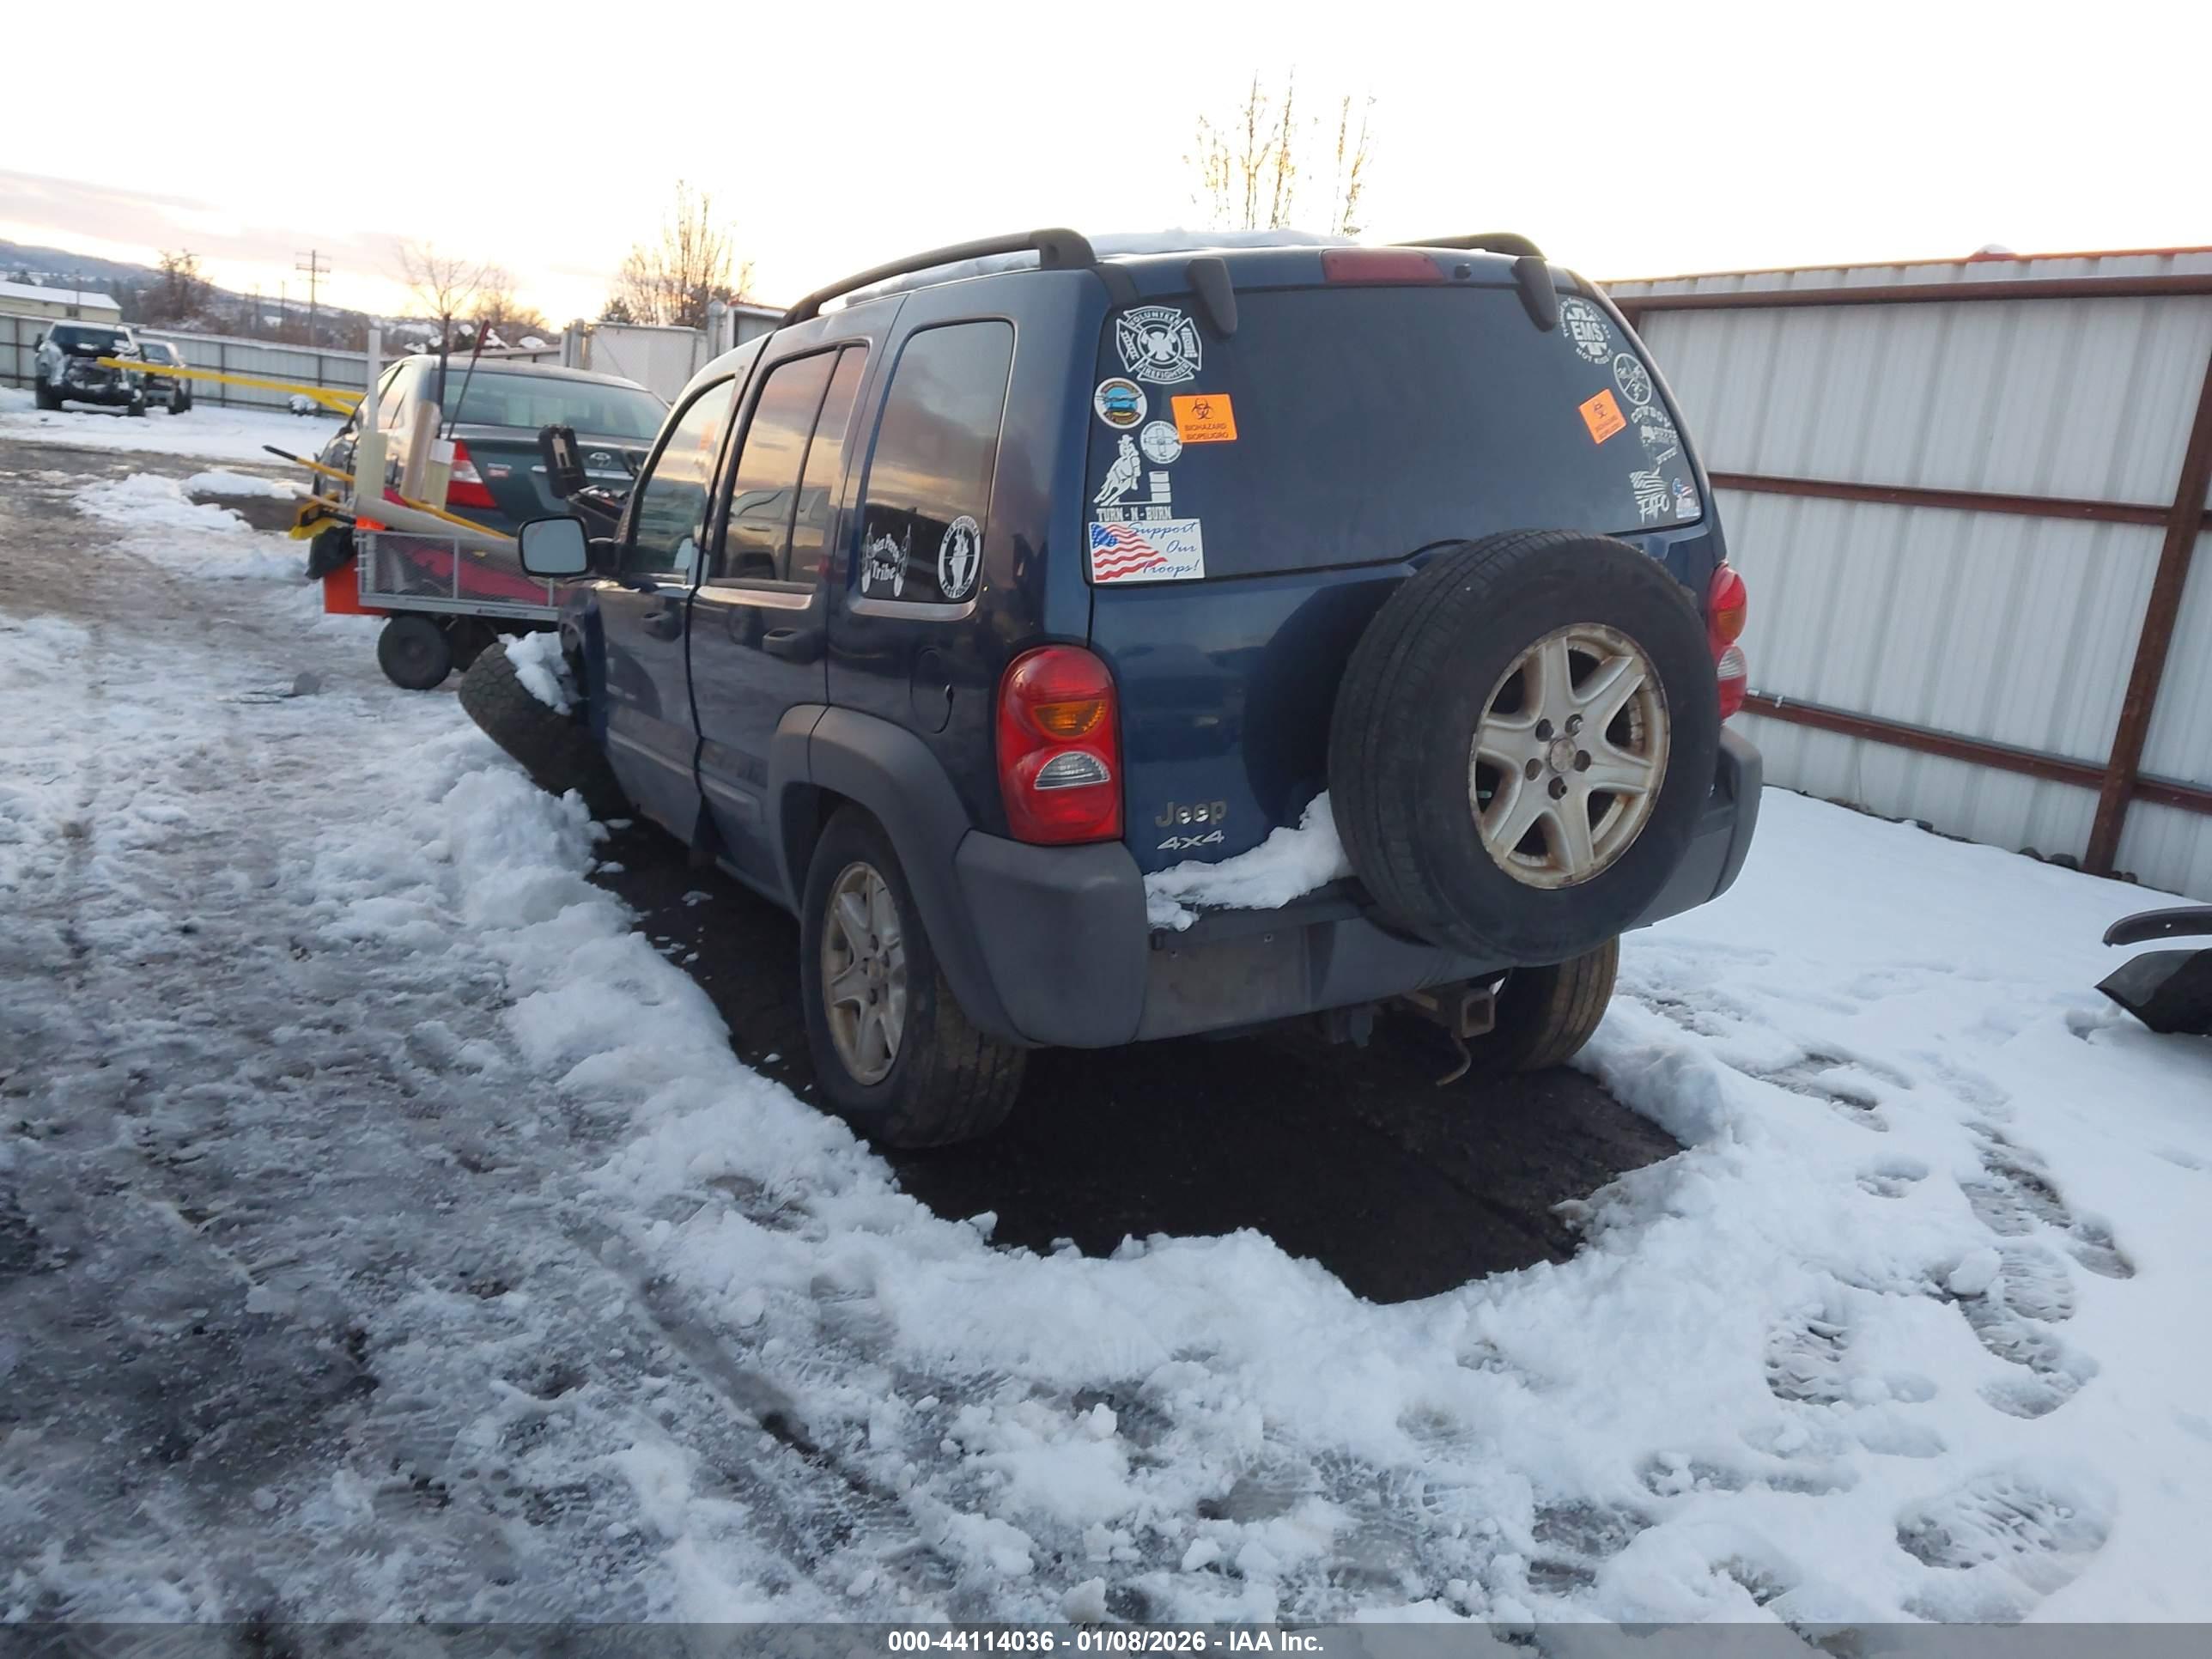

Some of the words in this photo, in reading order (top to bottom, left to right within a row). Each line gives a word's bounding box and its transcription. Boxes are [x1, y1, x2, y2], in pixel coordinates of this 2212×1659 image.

[1127, 311, 1182, 326] VOLUNTEER
[1571, 321, 1604, 342] EMS
[1137, 362, 1191, 379] FIREFIGHTER
[1096, 508, 1123, 522] TURN
[1146, 507, 1172, 520] BURN
[1127, 522, 1197, 539] Support
[1166, 540, 1197, 552] Our
[872, 560, 896, 580] Tribe
[1154, 799, 1227, 828] Jeep
